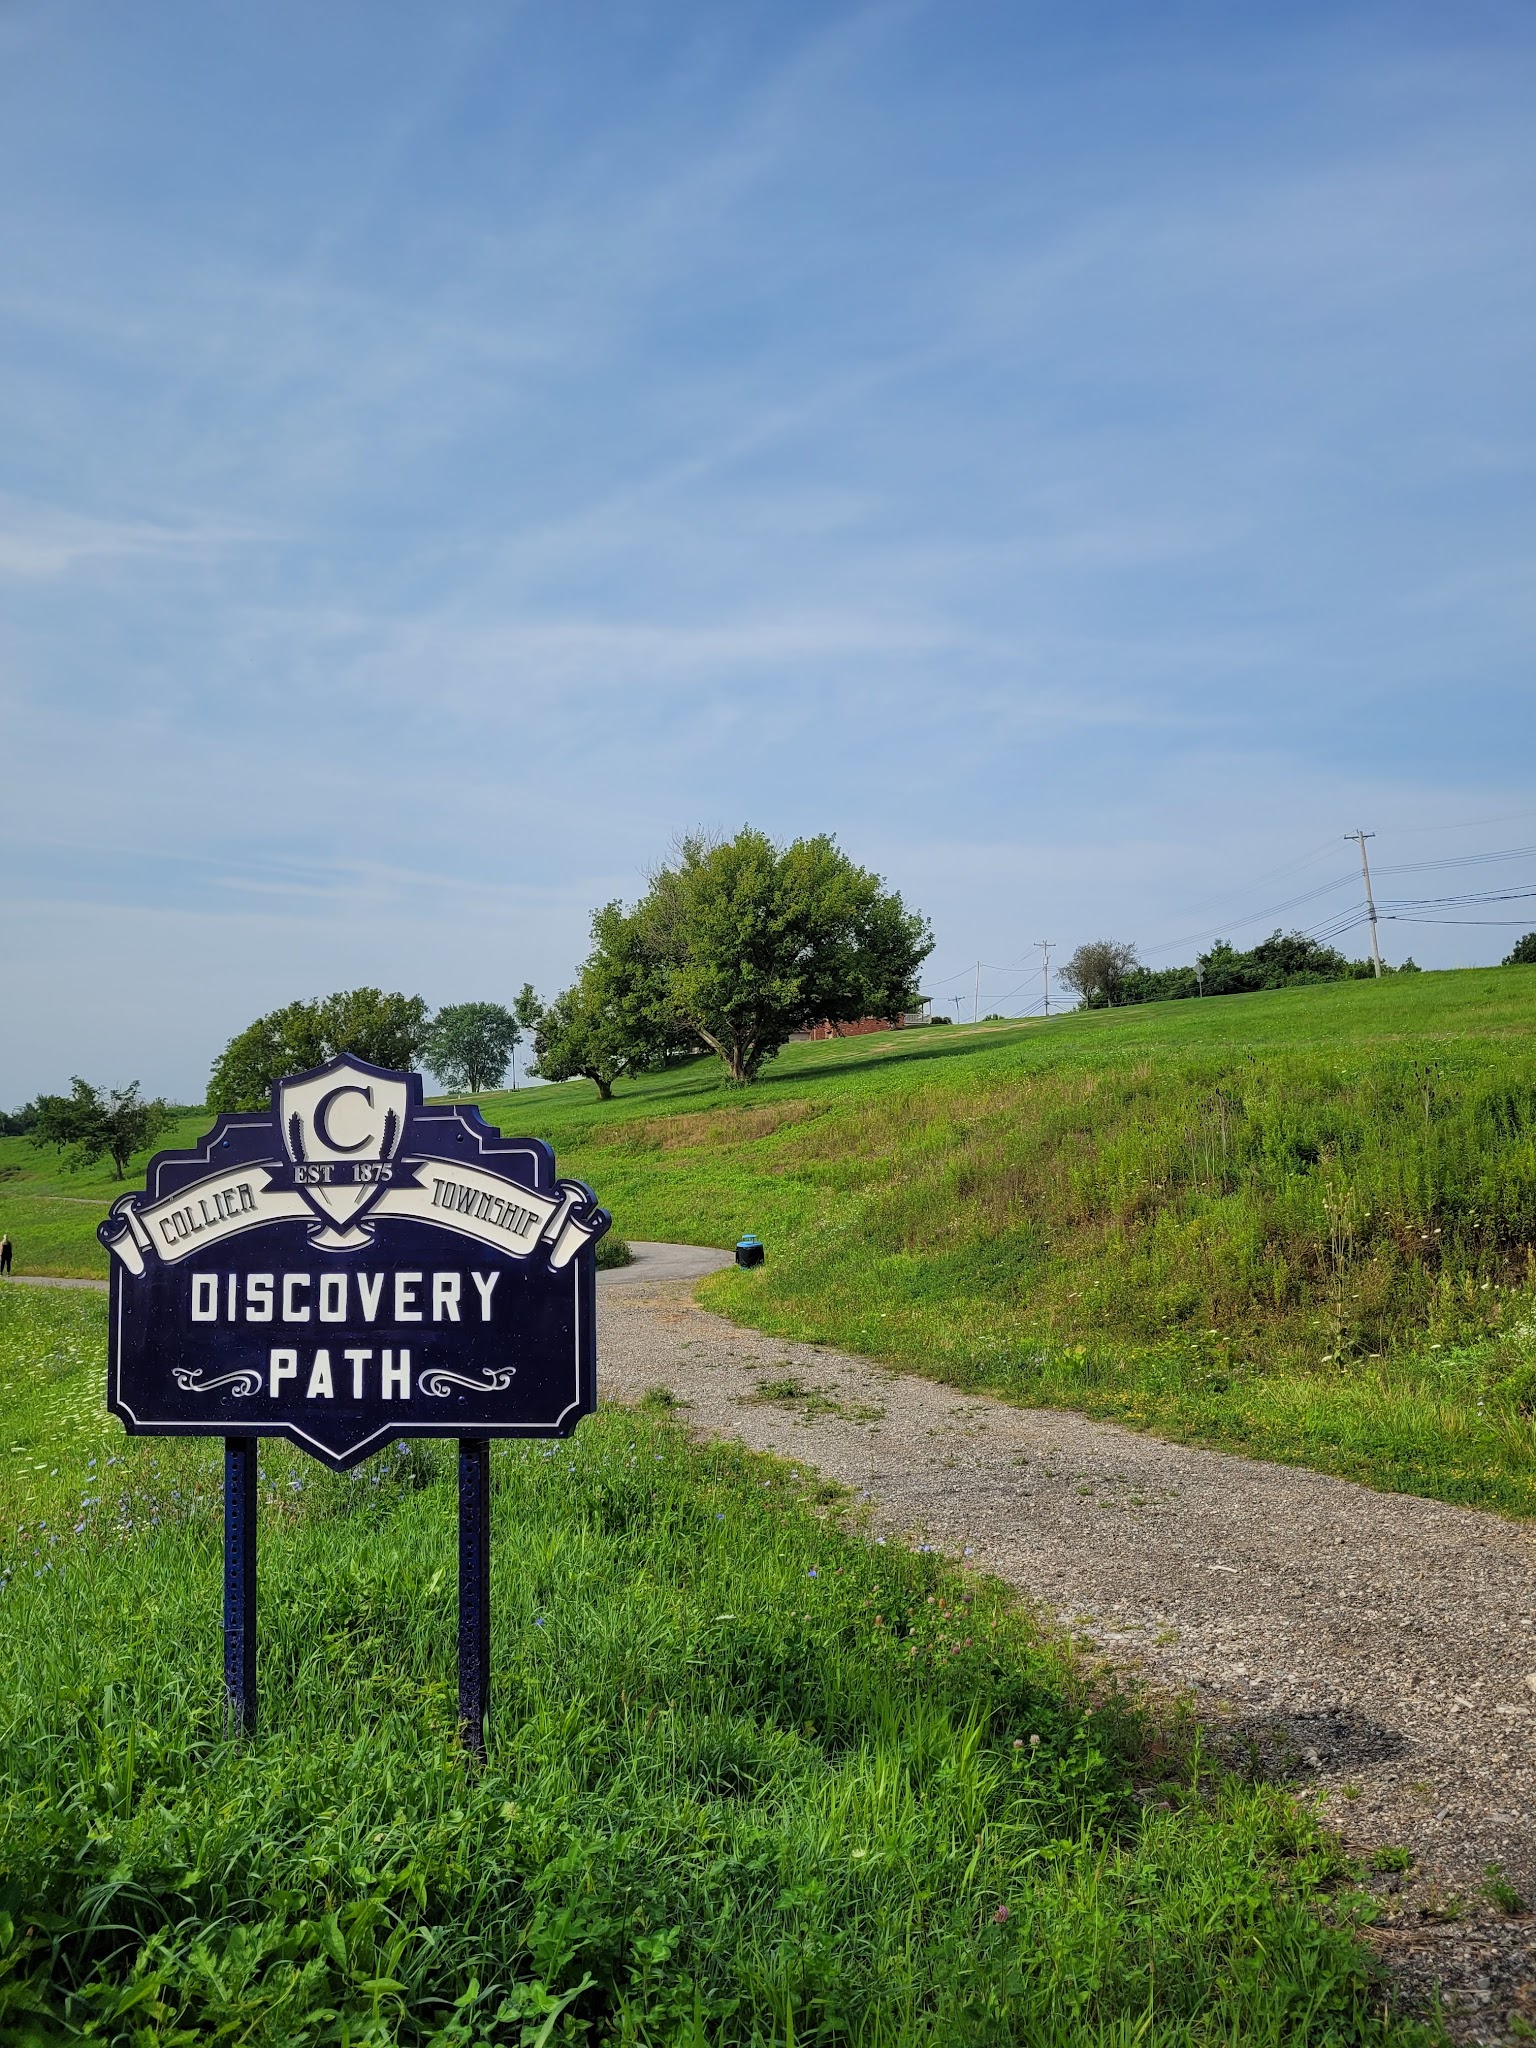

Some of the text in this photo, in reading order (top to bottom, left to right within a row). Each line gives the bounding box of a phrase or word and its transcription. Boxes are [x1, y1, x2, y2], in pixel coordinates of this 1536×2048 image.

[313, 1085, 375, 1153] C
[293, 1162, 393, 1184] EST 1875
[158, 1178, 541, 1244] COLLIER TOWNSHIP
[191, 1271, 500, 1322] DISCOVERY
[269, 1349, 411, 1399] PATH
